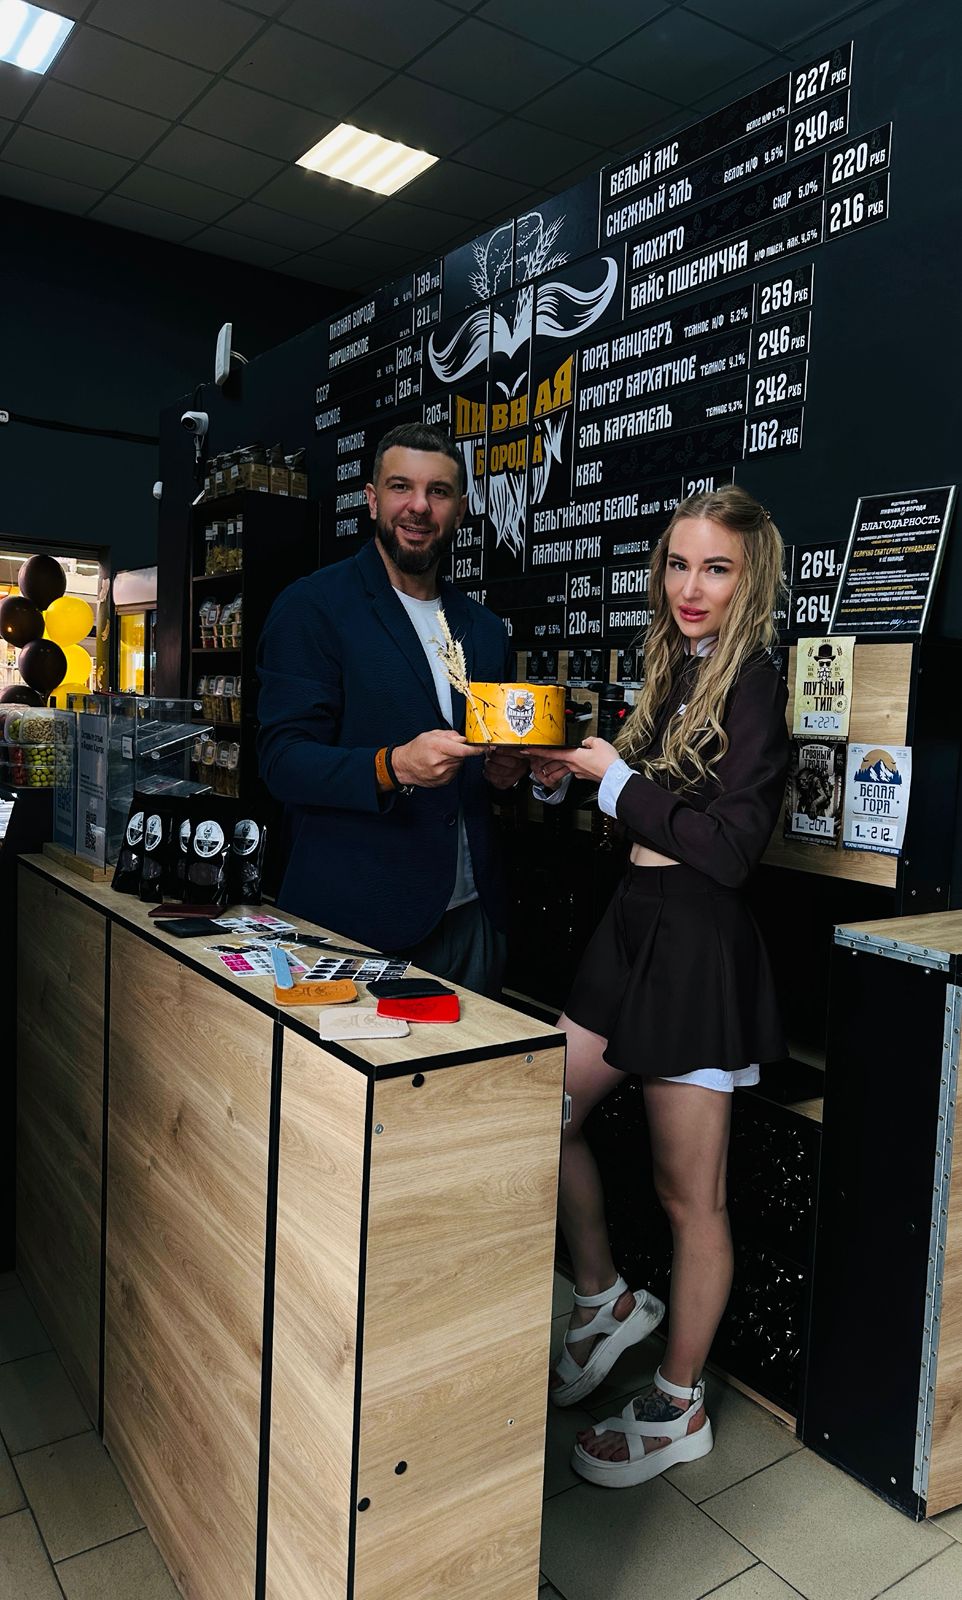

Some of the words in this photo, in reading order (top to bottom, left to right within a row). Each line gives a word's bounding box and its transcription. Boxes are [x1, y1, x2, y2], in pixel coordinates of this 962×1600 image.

[794, 60, 830, 104] 227
[830, 67, 847, 87] РУБ
[794, 110, 828, 152] 240
[829, 116, 845, 136] РУБ
[610, 150, 651, 197] БЕЛЫЙ
[654, 141, 679, 175] ЛИС
[831, 142, 868, 184] 220
[869, 148, 886, 168] РУБ
[606, 183, 666, 238] СНЕЖНЫЙ
[668, 177, 693, 209] ЭЛЬ
[723, 163, 745, 184] БЕЛОЕ
[745, 156, 759, 174] Н/Ф
[764, 145, 784, 165] 4.5%
[632, 226, 685, 271] МОХИТО
[773, 190, 792, 210] СИДР
[798, 180, 818, 199] 5.0%
[829, 192, 864, 234] 216
[867, 199, 884, 218] РУБ
[417, 272, 431, 297] 199
[630, 273, 665, 311] ВАЙС
[667, 239, 749, 296] ПШЕНИЧКА
[761, 279, 793, 315] 259
[794, 287, 809, 304] РУБ
[416, 305, 430, 328] 211
[582, 348, 609, 373] ЛОРД
[611, 320, 673, 362] КАНЦЛЕРЪ
[684, 320, 710, 338] ТЕМНОЕ
[730, 307, 748, 323] 5.2%
[758, 326, 790, 361] 246
[791, 334, 805, 351] РУБ
[398, 345, 412, 370] 202
[399, 377, 412, 399] 215
[455, 354, 574, 435] ПИВНАЯ
[579, 378, 624, 412] КРЮГЕР
[626, 354, 697, 393] БАРХАТНОЕ
[700, 358, 726, 377] ТЕМНОЕ
[755, 373, 788, 407] 242
[788, 384, 802, 399] РУБ
[426, 403, 442, 425] 203
[578, 423, 601, 449] ЭЛЬ
[604, 404, 673, 443] КАРАМЕЛЬ
[749, 419, 779, 453] 162
[780, 426, 799, 447] РУБ
[475, 434, 543, 476] БОРОДА
[576, 460, 603, 487] КВАС
[533, 499, 601, 534] БЕЛЬГИЙСКОЕ
[604, 493, 639, 521] БЕЛОЕ
[860, 515, 941, 532] БЛАГОДАРНОСТЬ
[456, 527, 473, 548] 213
[532, 538, 573, 566] ЛАМБИК
[574, 535, 602, 561] КРИК
[456, 558, 472, 579] 213
[801, 549, 836, 580] 264
[570, 575, 591, 599] 235
[568, 610, 587, 635] 218
[588, 619, 600, 634] РУБ
[796, 594, 831, 623] 264
[803, 678, 845, 696] МУТНЫЙ
[813, 696, 833, 712] ТИП
[801, 748, 832, 761] ГРОЗНЫЙ
[859, 783, 896, 800] БЕЛАЯ
[862, 798, 891, 815] ГОРА
